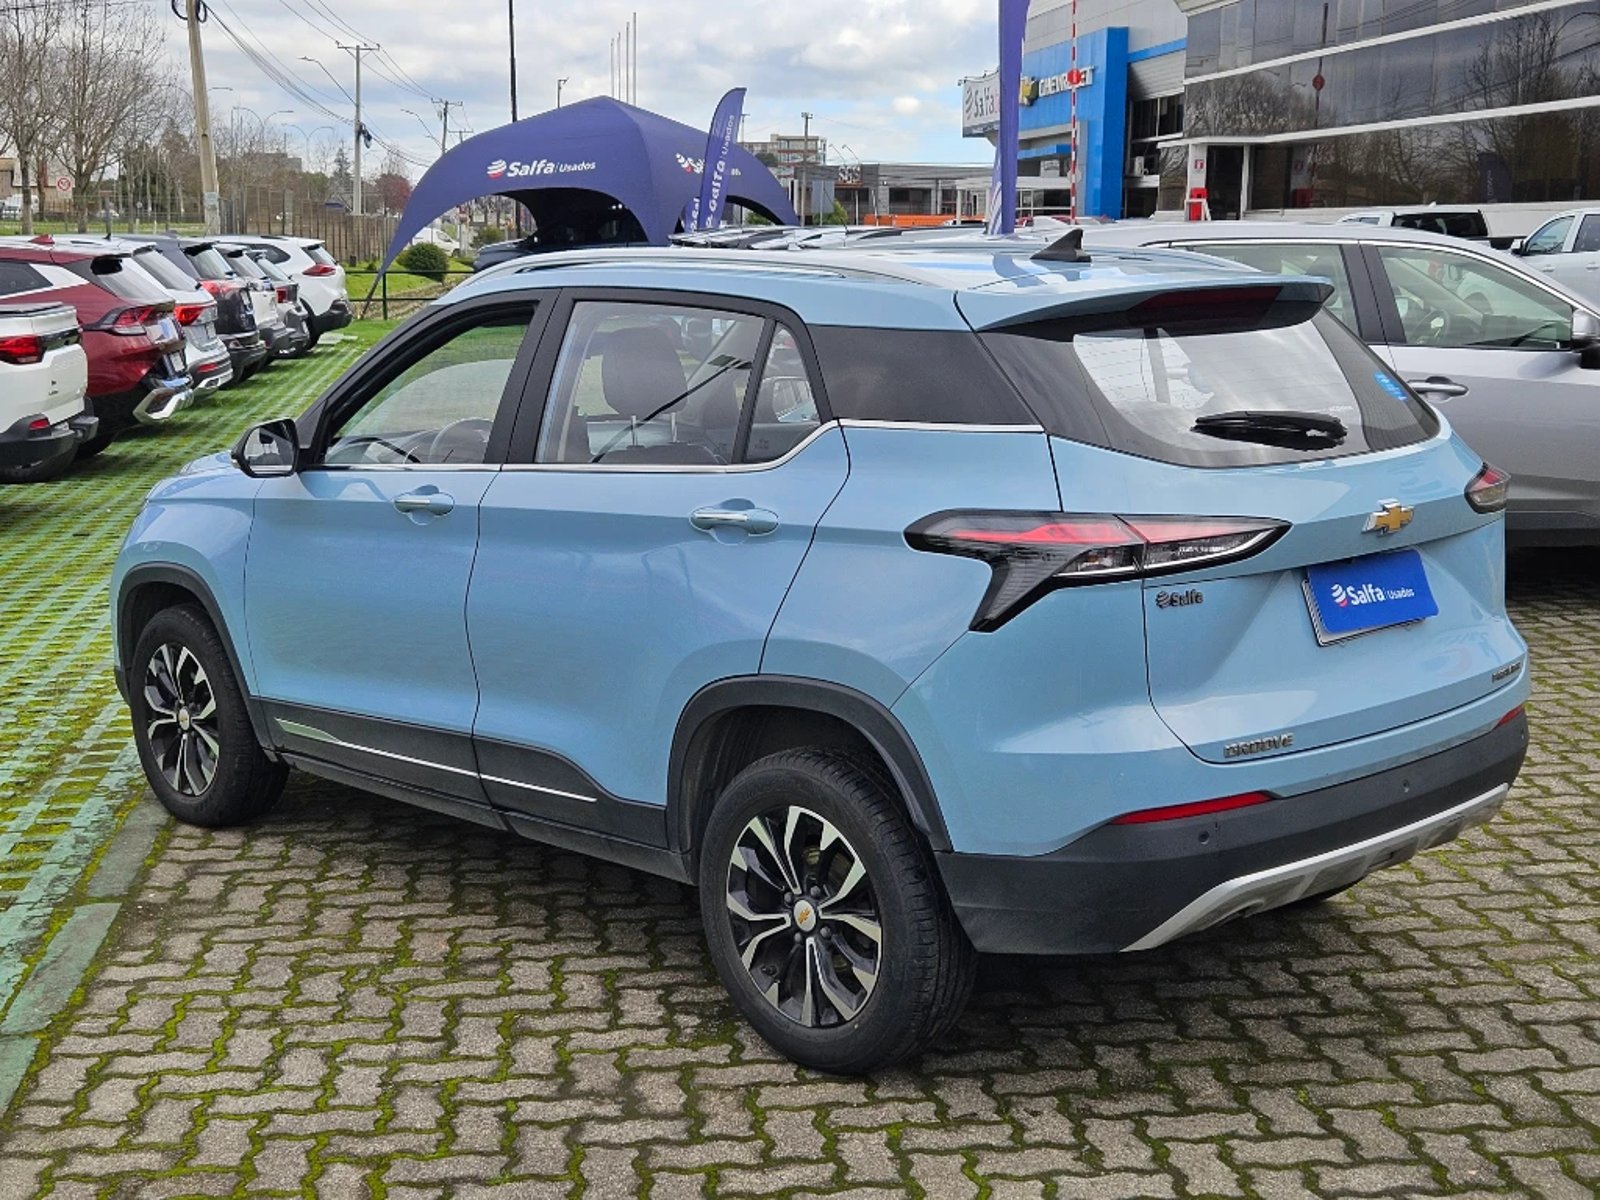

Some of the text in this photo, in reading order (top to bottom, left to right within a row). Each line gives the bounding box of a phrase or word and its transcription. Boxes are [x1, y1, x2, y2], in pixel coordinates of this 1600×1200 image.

[1039, 65, 1096, 98] CHEVRET
[507, 160, 596, 177] Salfa Usados
[1170, 589, 1203, 607] Salfa
[1347, 583, 1415, 605] Salfa Usados
